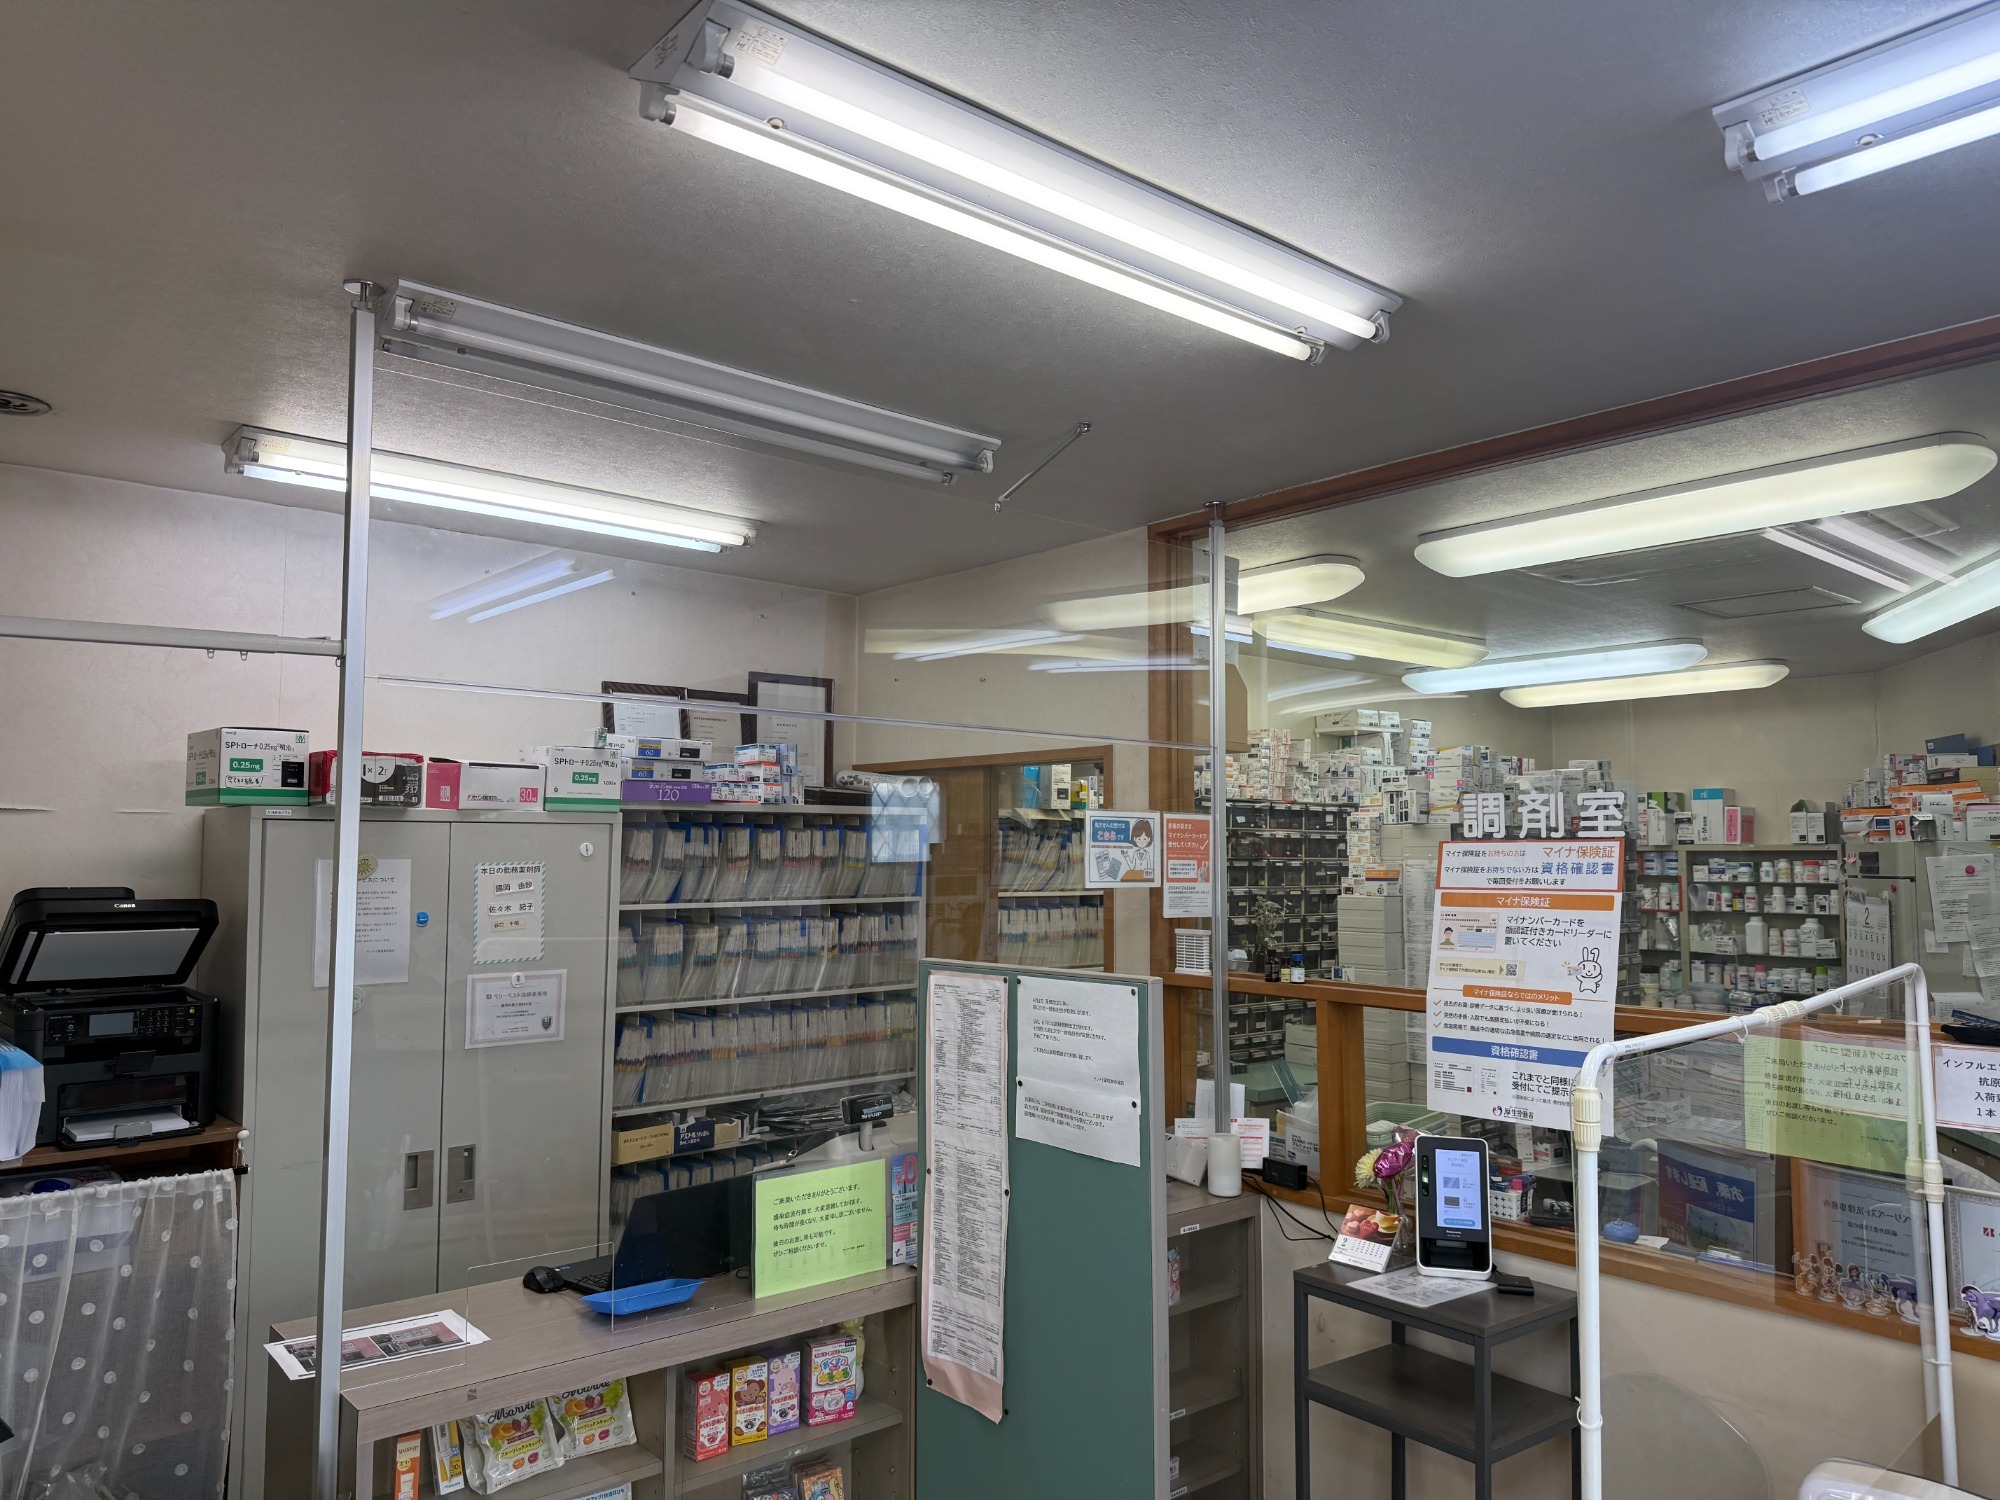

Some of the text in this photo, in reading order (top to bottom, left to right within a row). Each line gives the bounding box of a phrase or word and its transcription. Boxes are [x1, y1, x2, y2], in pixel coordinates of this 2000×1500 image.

[232, 761, 261, 770] 0.25mg
[574, 774, 597, 782] 0.25mg
[658, 790, 680, 801] 120
[1462, 789, 1625, 838] 調剤室
[1542, 846, 1615, 858] マイナ保険証
[480, 866, 540, 875] 本日の勤務薬剤師
[1444, 862, 1614, 875] マイナ保険証をお持ちでない方は 資格確認書
[1486, 878, 1566, 886] で毎回受付をお願いします
[1496, 896, 1550, 908] マイナ保険証
[488, 904, 512, 914] 佐々木
[1506, 916, 1584, 928] マイナンバーカードを
[1864, 907, 1870, 926] 2
[1504, 926, 1612, 939] 顔認証付きカードリーダーに
[1504, 936, 1562, 947] 置いてください
[1473, 990, 1560, 1002] マイナ保険証ならではのメリット
[1490, 1046, 1538, 1060] 資格確認書
[1512, 1071, 1577, 1087] これまでと同様に
[861, 1112, 882, 1120] SHARP
[1976, 1107, 1996, 1118] 1本
[822, 1358, 848, 1370] おくすり
[398, 1445, 418, 1454] yuskin
